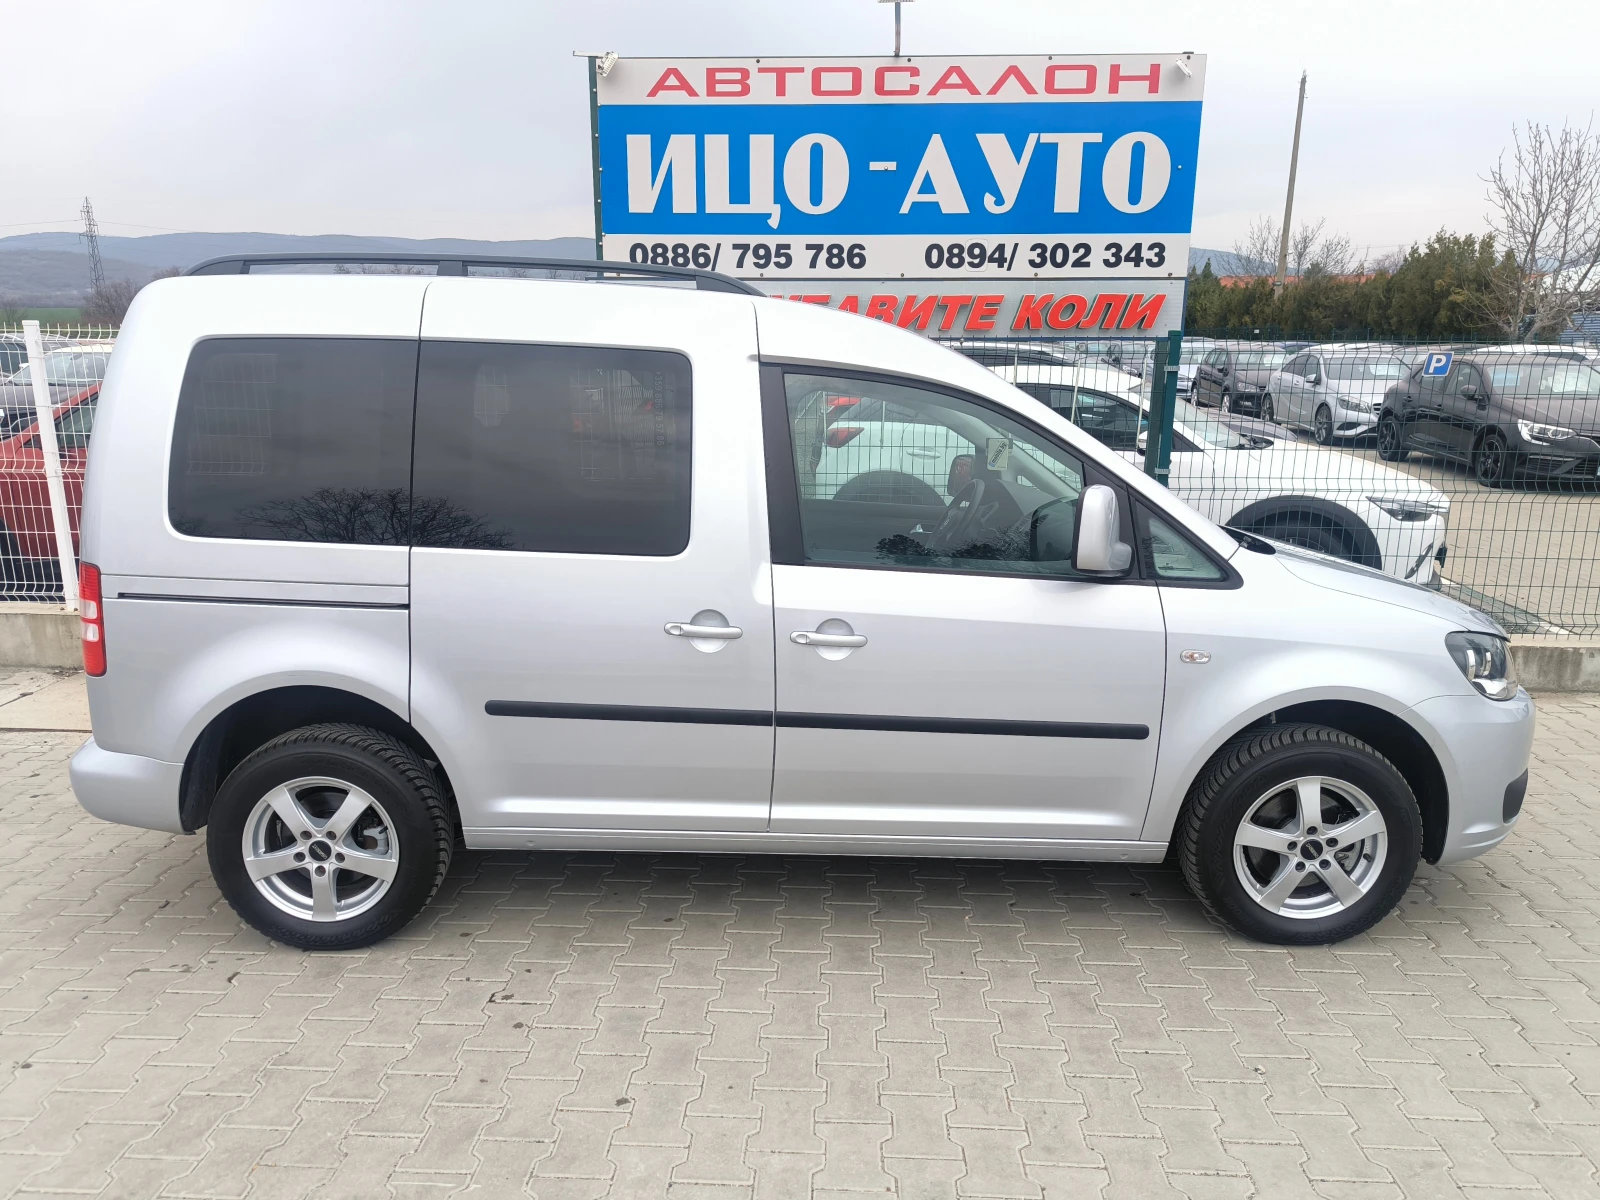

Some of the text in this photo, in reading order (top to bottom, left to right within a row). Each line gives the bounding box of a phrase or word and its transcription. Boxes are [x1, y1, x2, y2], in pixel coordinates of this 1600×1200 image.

[646, 63, 1162, 98] АВТОСАЛОН
[629, 242, 867, 272] 0886/ 795 786
[924, 242, 1167, 272] 0894/ 302 343
[1011, 293, 1168, 331] КОЛИ
[1428, 354, 1447, 374] P
